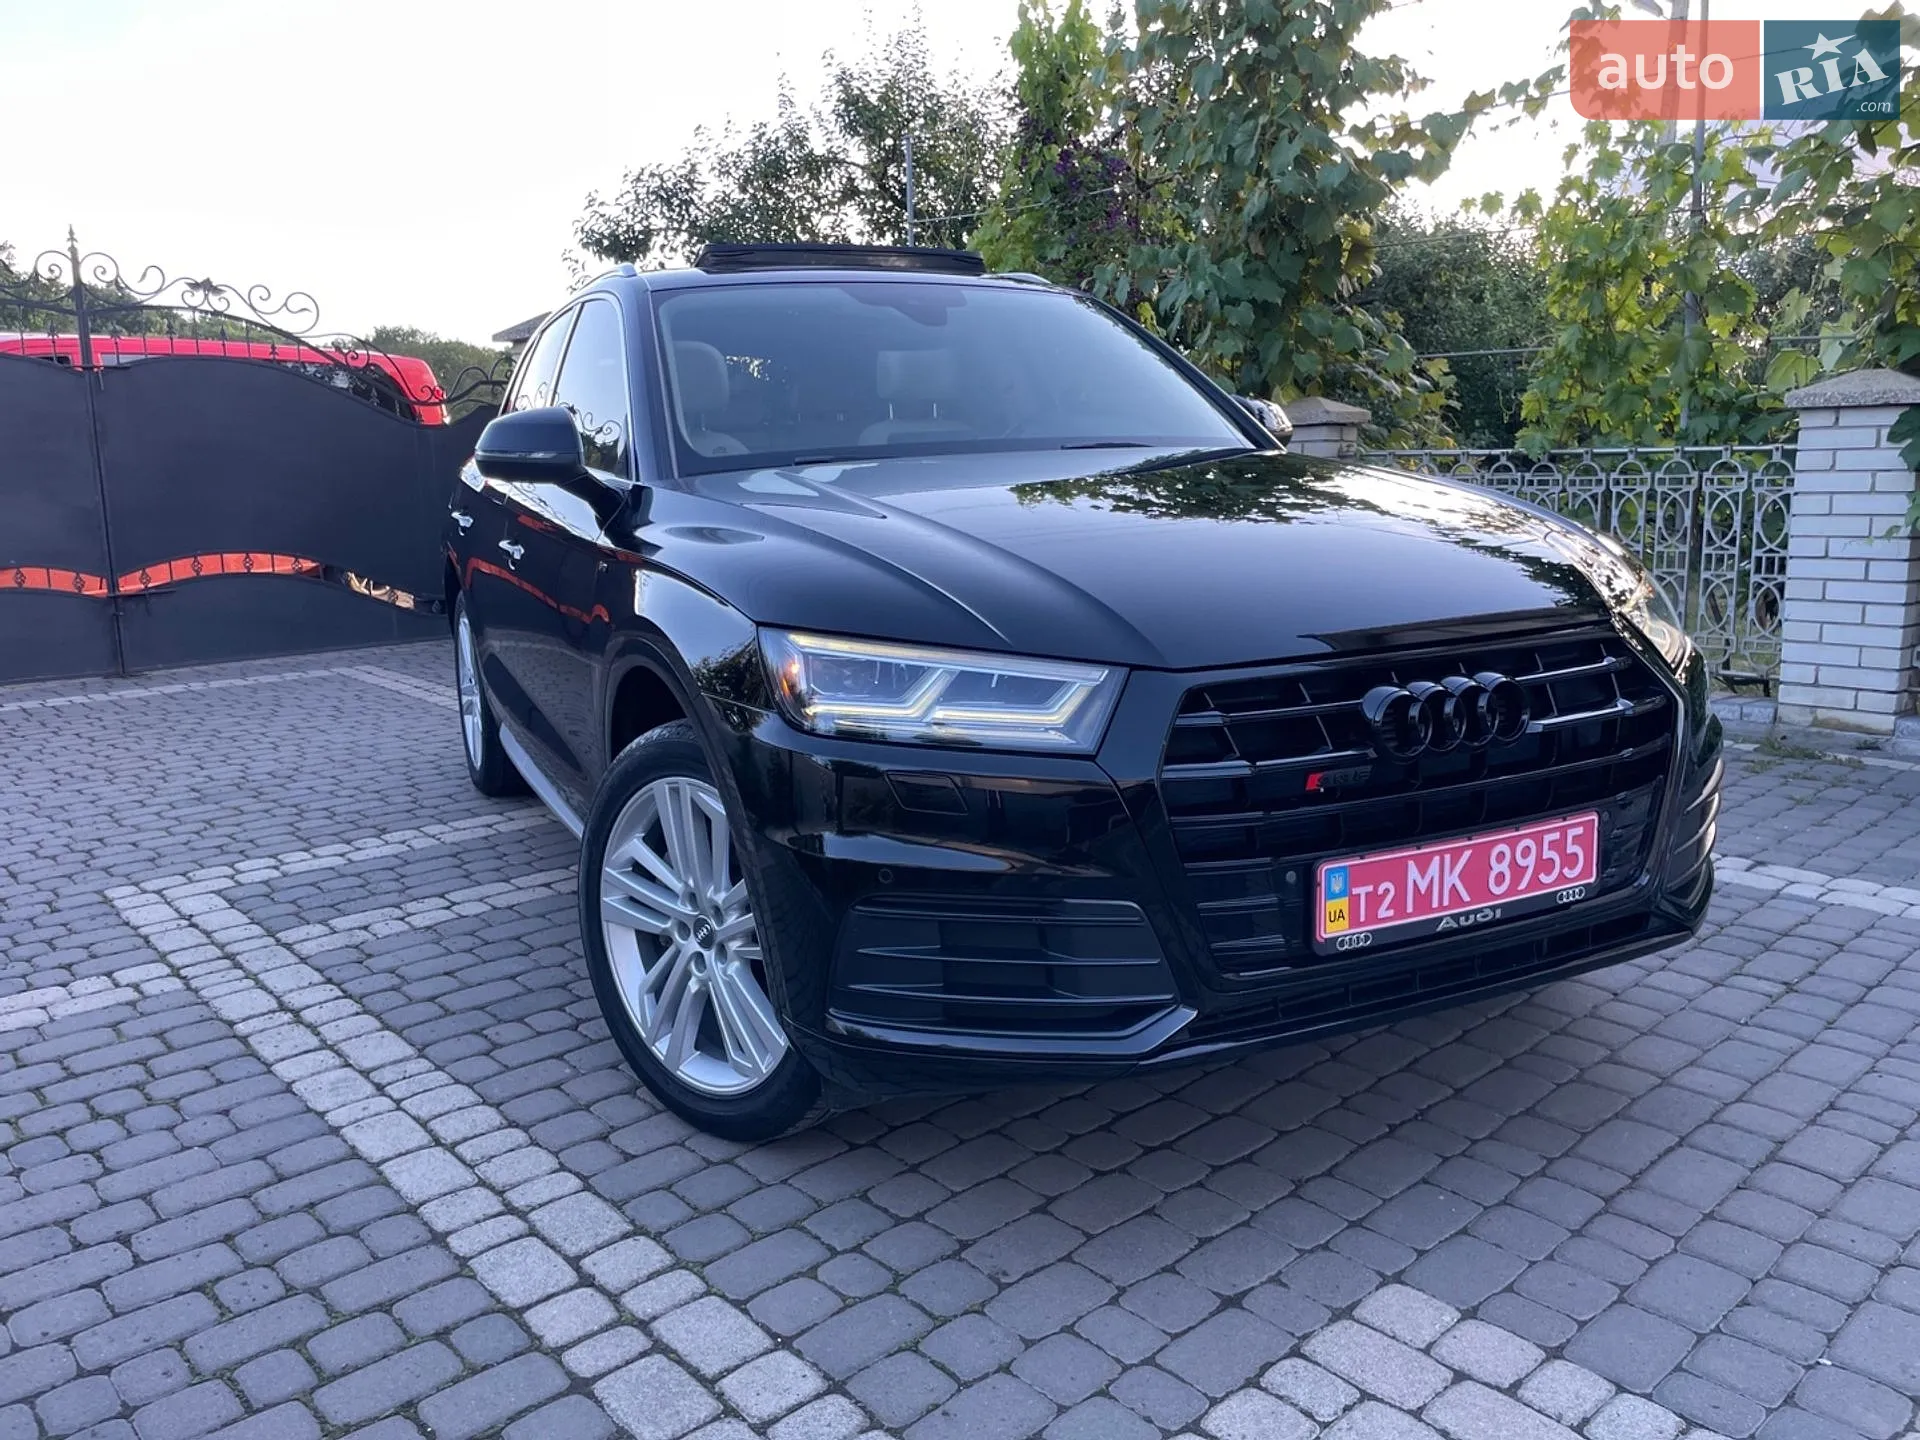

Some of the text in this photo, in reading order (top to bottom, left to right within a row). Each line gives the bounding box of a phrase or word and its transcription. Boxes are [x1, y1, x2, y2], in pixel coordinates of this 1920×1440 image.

[1352, 826, 1584, 922] T2 MK 8955
[1328, 908, 1346, 923] UA
[1435, 908, 1502, 932] Audi
